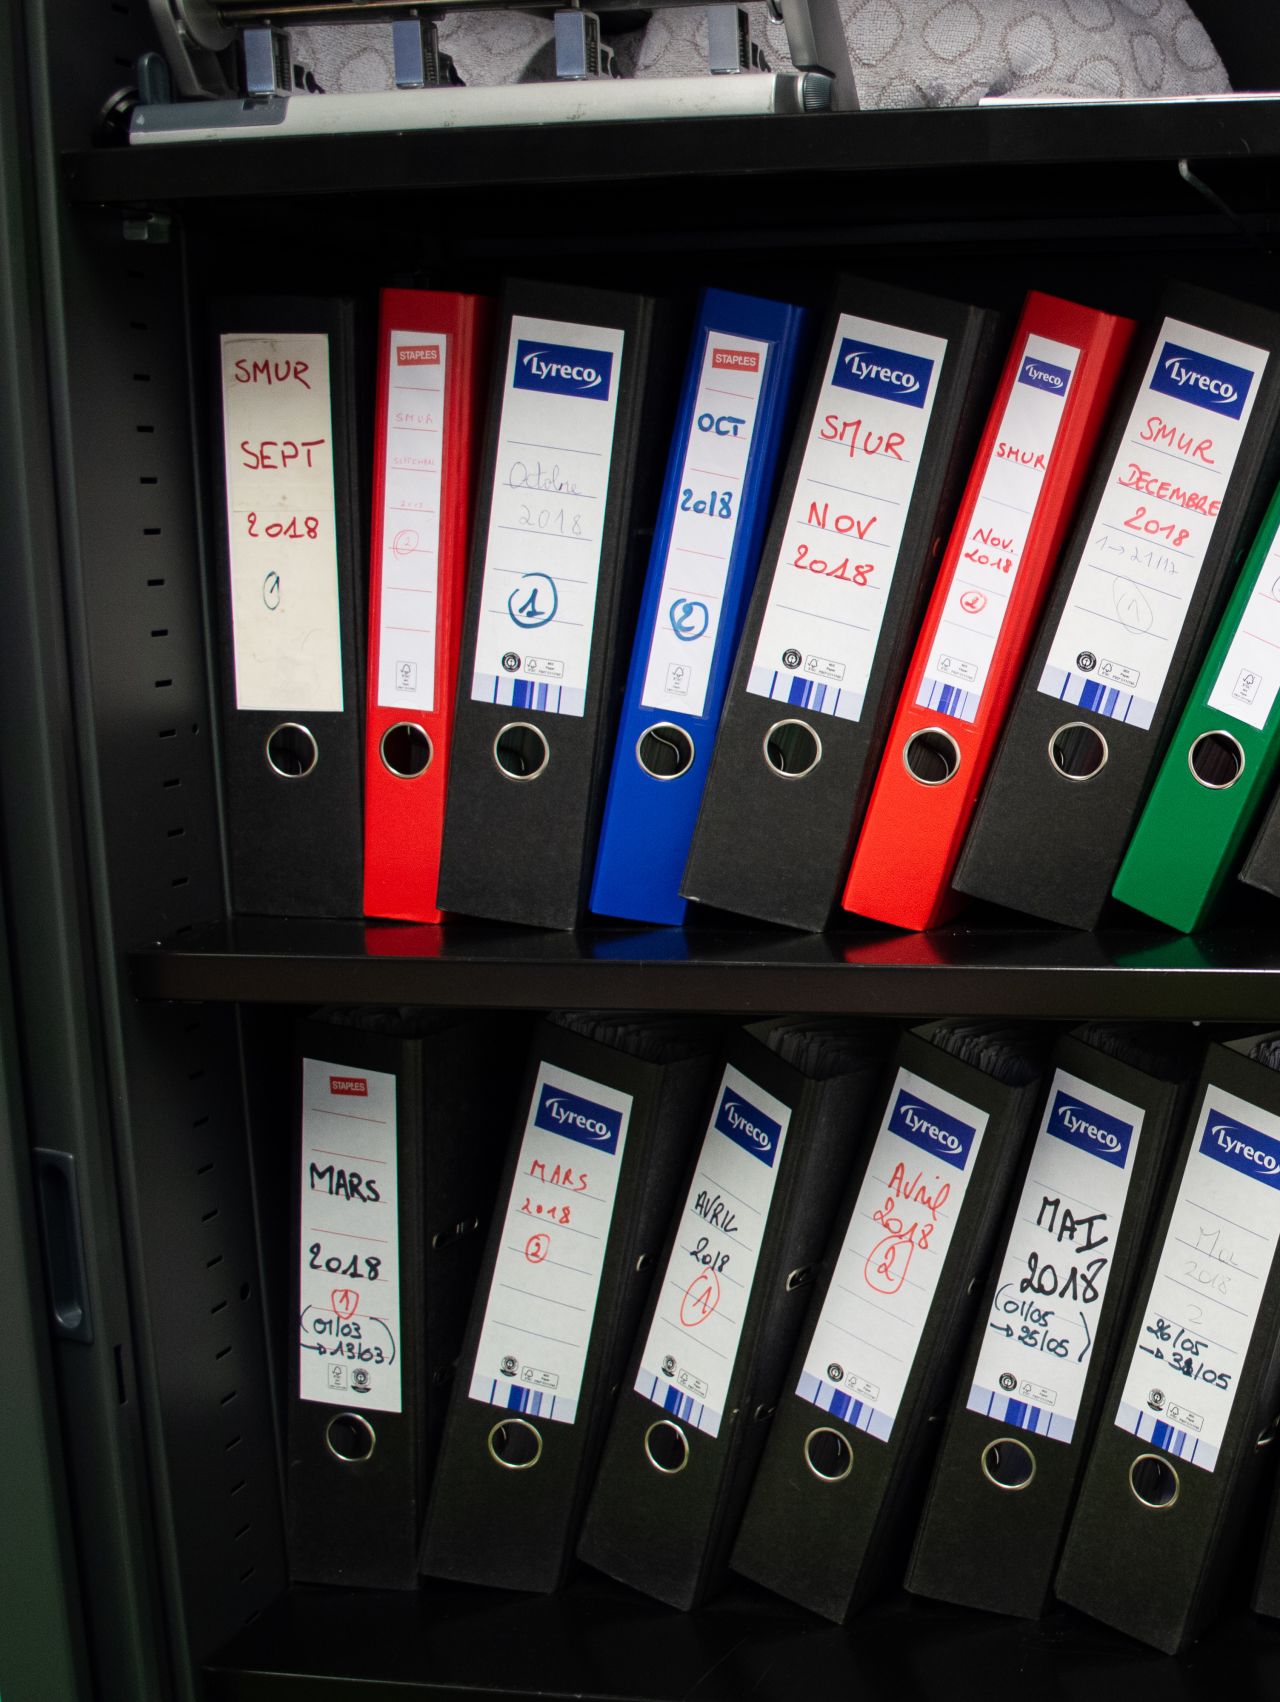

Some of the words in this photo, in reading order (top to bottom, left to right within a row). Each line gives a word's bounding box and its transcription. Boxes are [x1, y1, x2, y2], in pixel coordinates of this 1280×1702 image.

[234, 359, 311, 389] SMUR
[399, 349, 438, 362] STAPLES
[530, 357, 597, 384] Lyreco
[714, 353, 757, 368] STAPLES
[851, 355, 915, 388] Lyreco
[1028, 365, 1062, 387] Lyreco
[1171, 360, 1235, 399] Lyreco
[698, 413, 746, 436] OCT
[820, 414, 906, 461] SMUR
[1140, 416, 1216, 465] SMUR
[241, 439, 325, 470] SEPT
[997, 442, 1046, 470] SMUR
[680, 489, 733, 520] 2018
[1117, 464, 1222, 517] DECEMBRE
[247, 512, 319, 538] 2018
[518, 504, 582, 536] 2018
[807, 502, 877, 540] NOV
[1123, 507, 1190, 547] 2018
[794, 544, 875, 586] 2018
[965, 549, 1012, 574] 2018
[332, 1080, 366, 1093] STAPLES
[551, 1103, 607, 1137] Lyreco
[728, 1105, 770, 1148] Lyreco
[905, 1107, 959, 1150] Lyreco
[1064, 1108, 1119, 1150] Lyreco
[1218, 1127, 1279, 1173] Lyreco
[310, 1163, 380, 1203] MARS
[530, 1159, 588, 1191] MARS
[521, 1198, 571, 1224] 2018
[695, 1190, 737, 1233] AVRIL
[873, 1197, 934, 1250] 2018
[1037, 1196, 1107, 1254] MAI
[310, 1243, 381, 1281] 2018
[690, 1237, 731, 1273] 2018
[1020, 1252, 1107, 1303] 2018
[1146, 1318, 1209, 1357] 26/05
